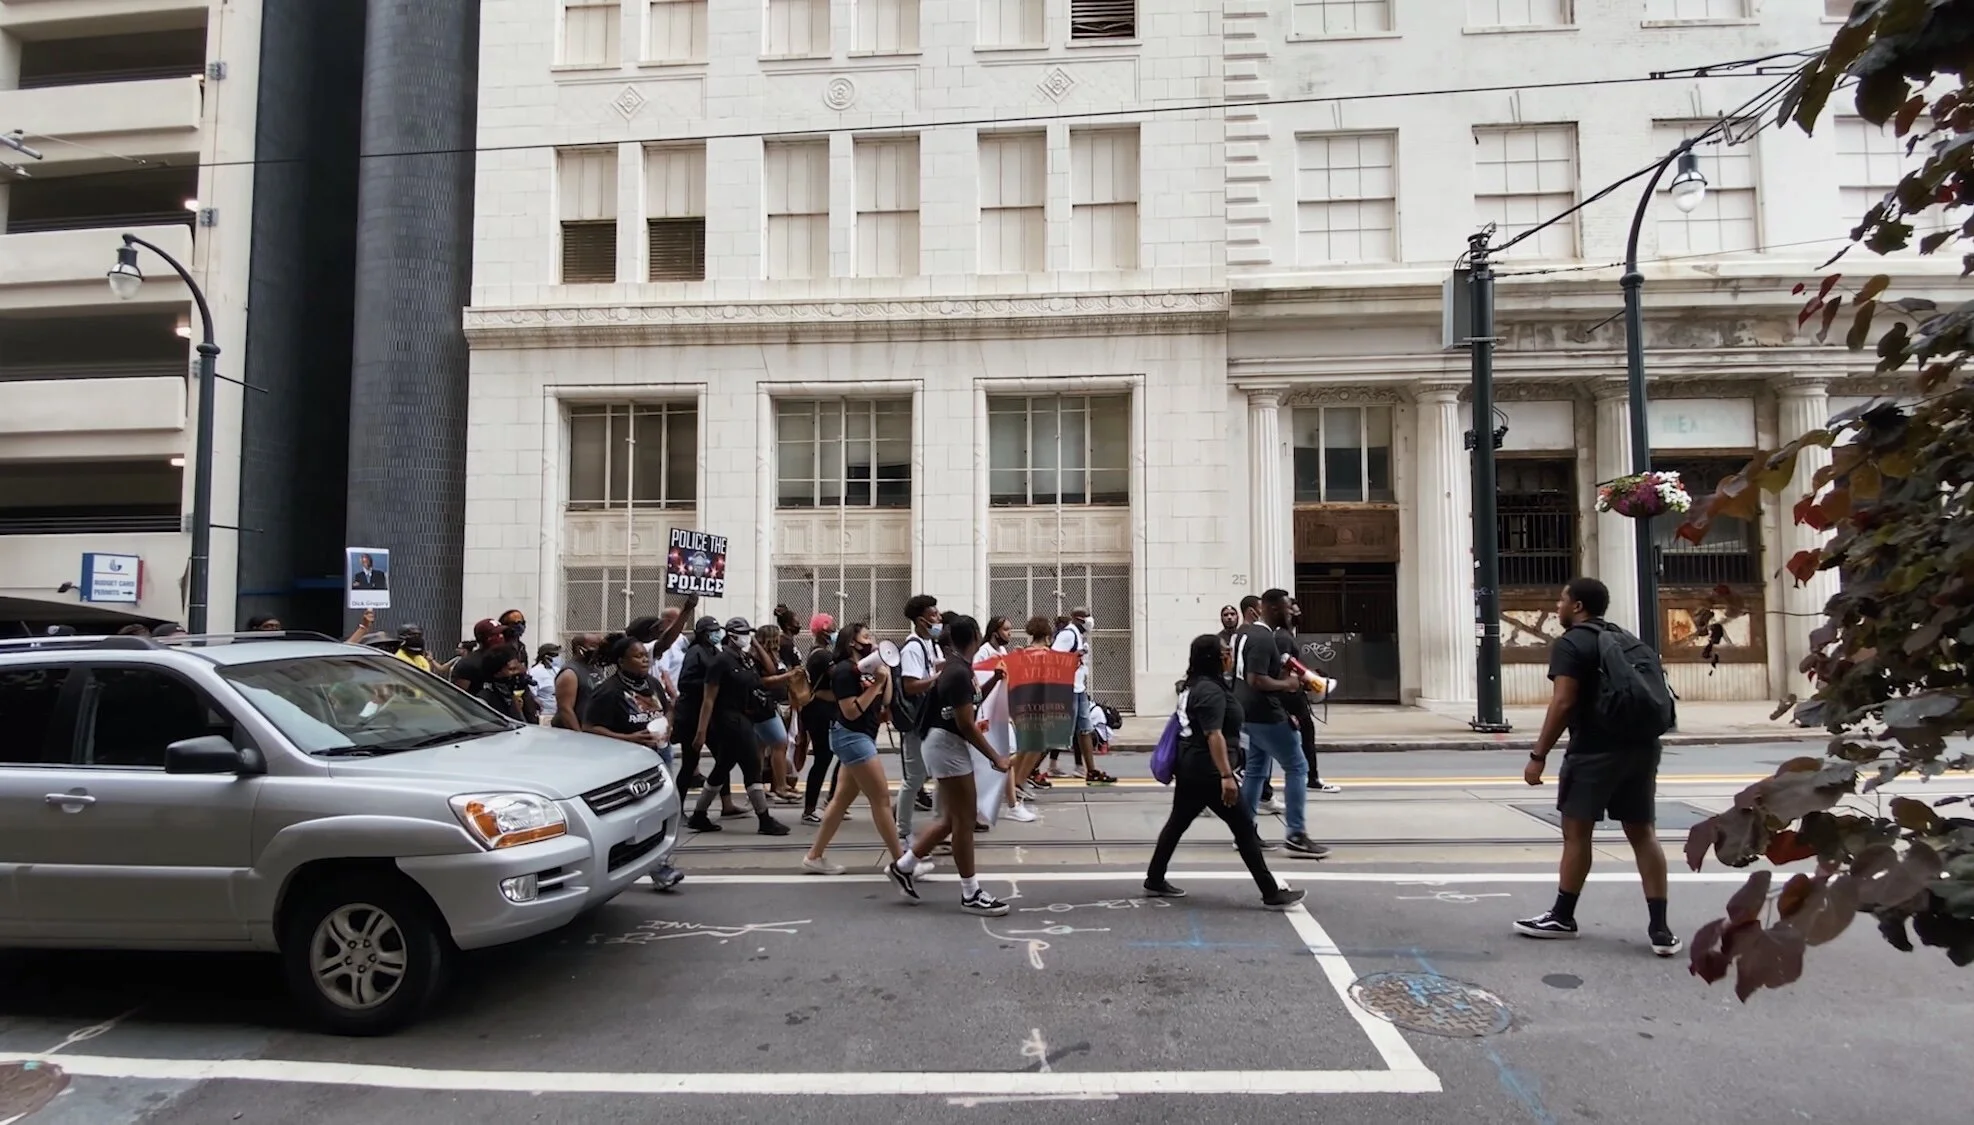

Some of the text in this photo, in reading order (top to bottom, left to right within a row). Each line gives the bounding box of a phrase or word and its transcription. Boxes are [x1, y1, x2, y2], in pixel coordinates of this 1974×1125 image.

[671, 528, 727, 554] POLICE THE
[667, 573, 724, 593] POLICE
[1231, 574, 1247, 585] 25
